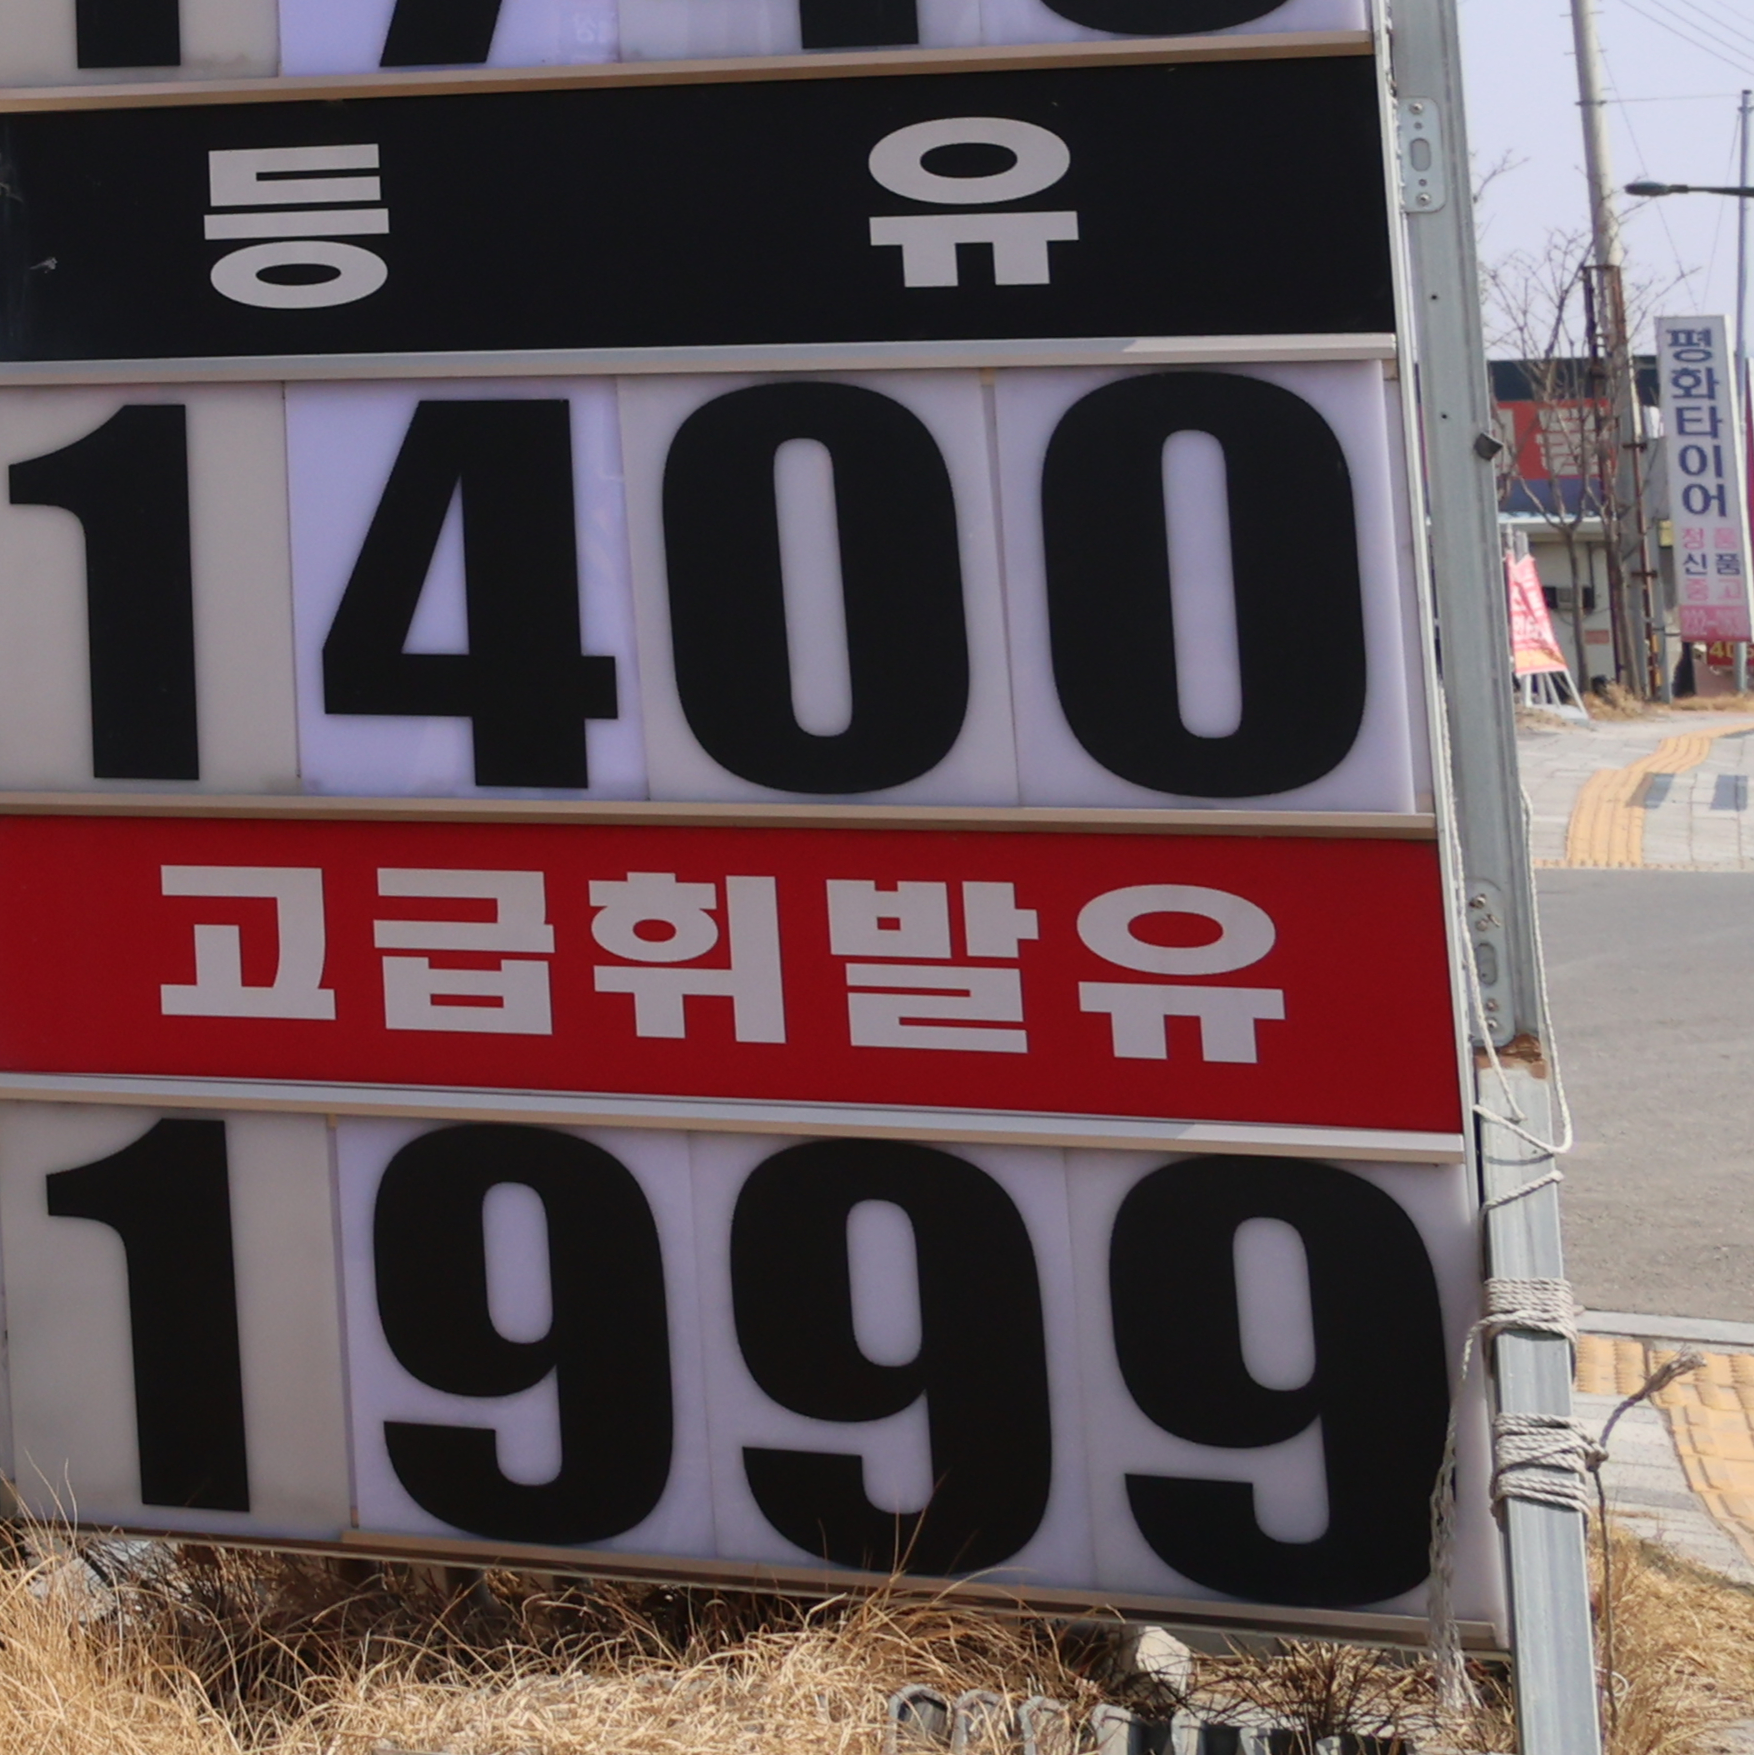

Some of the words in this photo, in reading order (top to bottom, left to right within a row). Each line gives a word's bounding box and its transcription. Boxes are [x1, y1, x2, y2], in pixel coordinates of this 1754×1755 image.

[1666, 329, 1727, 518] 평화타이어
[8, 371, 1367, 797] 1400
[160, 864, 1285, 1063] 고급휘발유
[44, 1118, 1452, 1606] 1999
